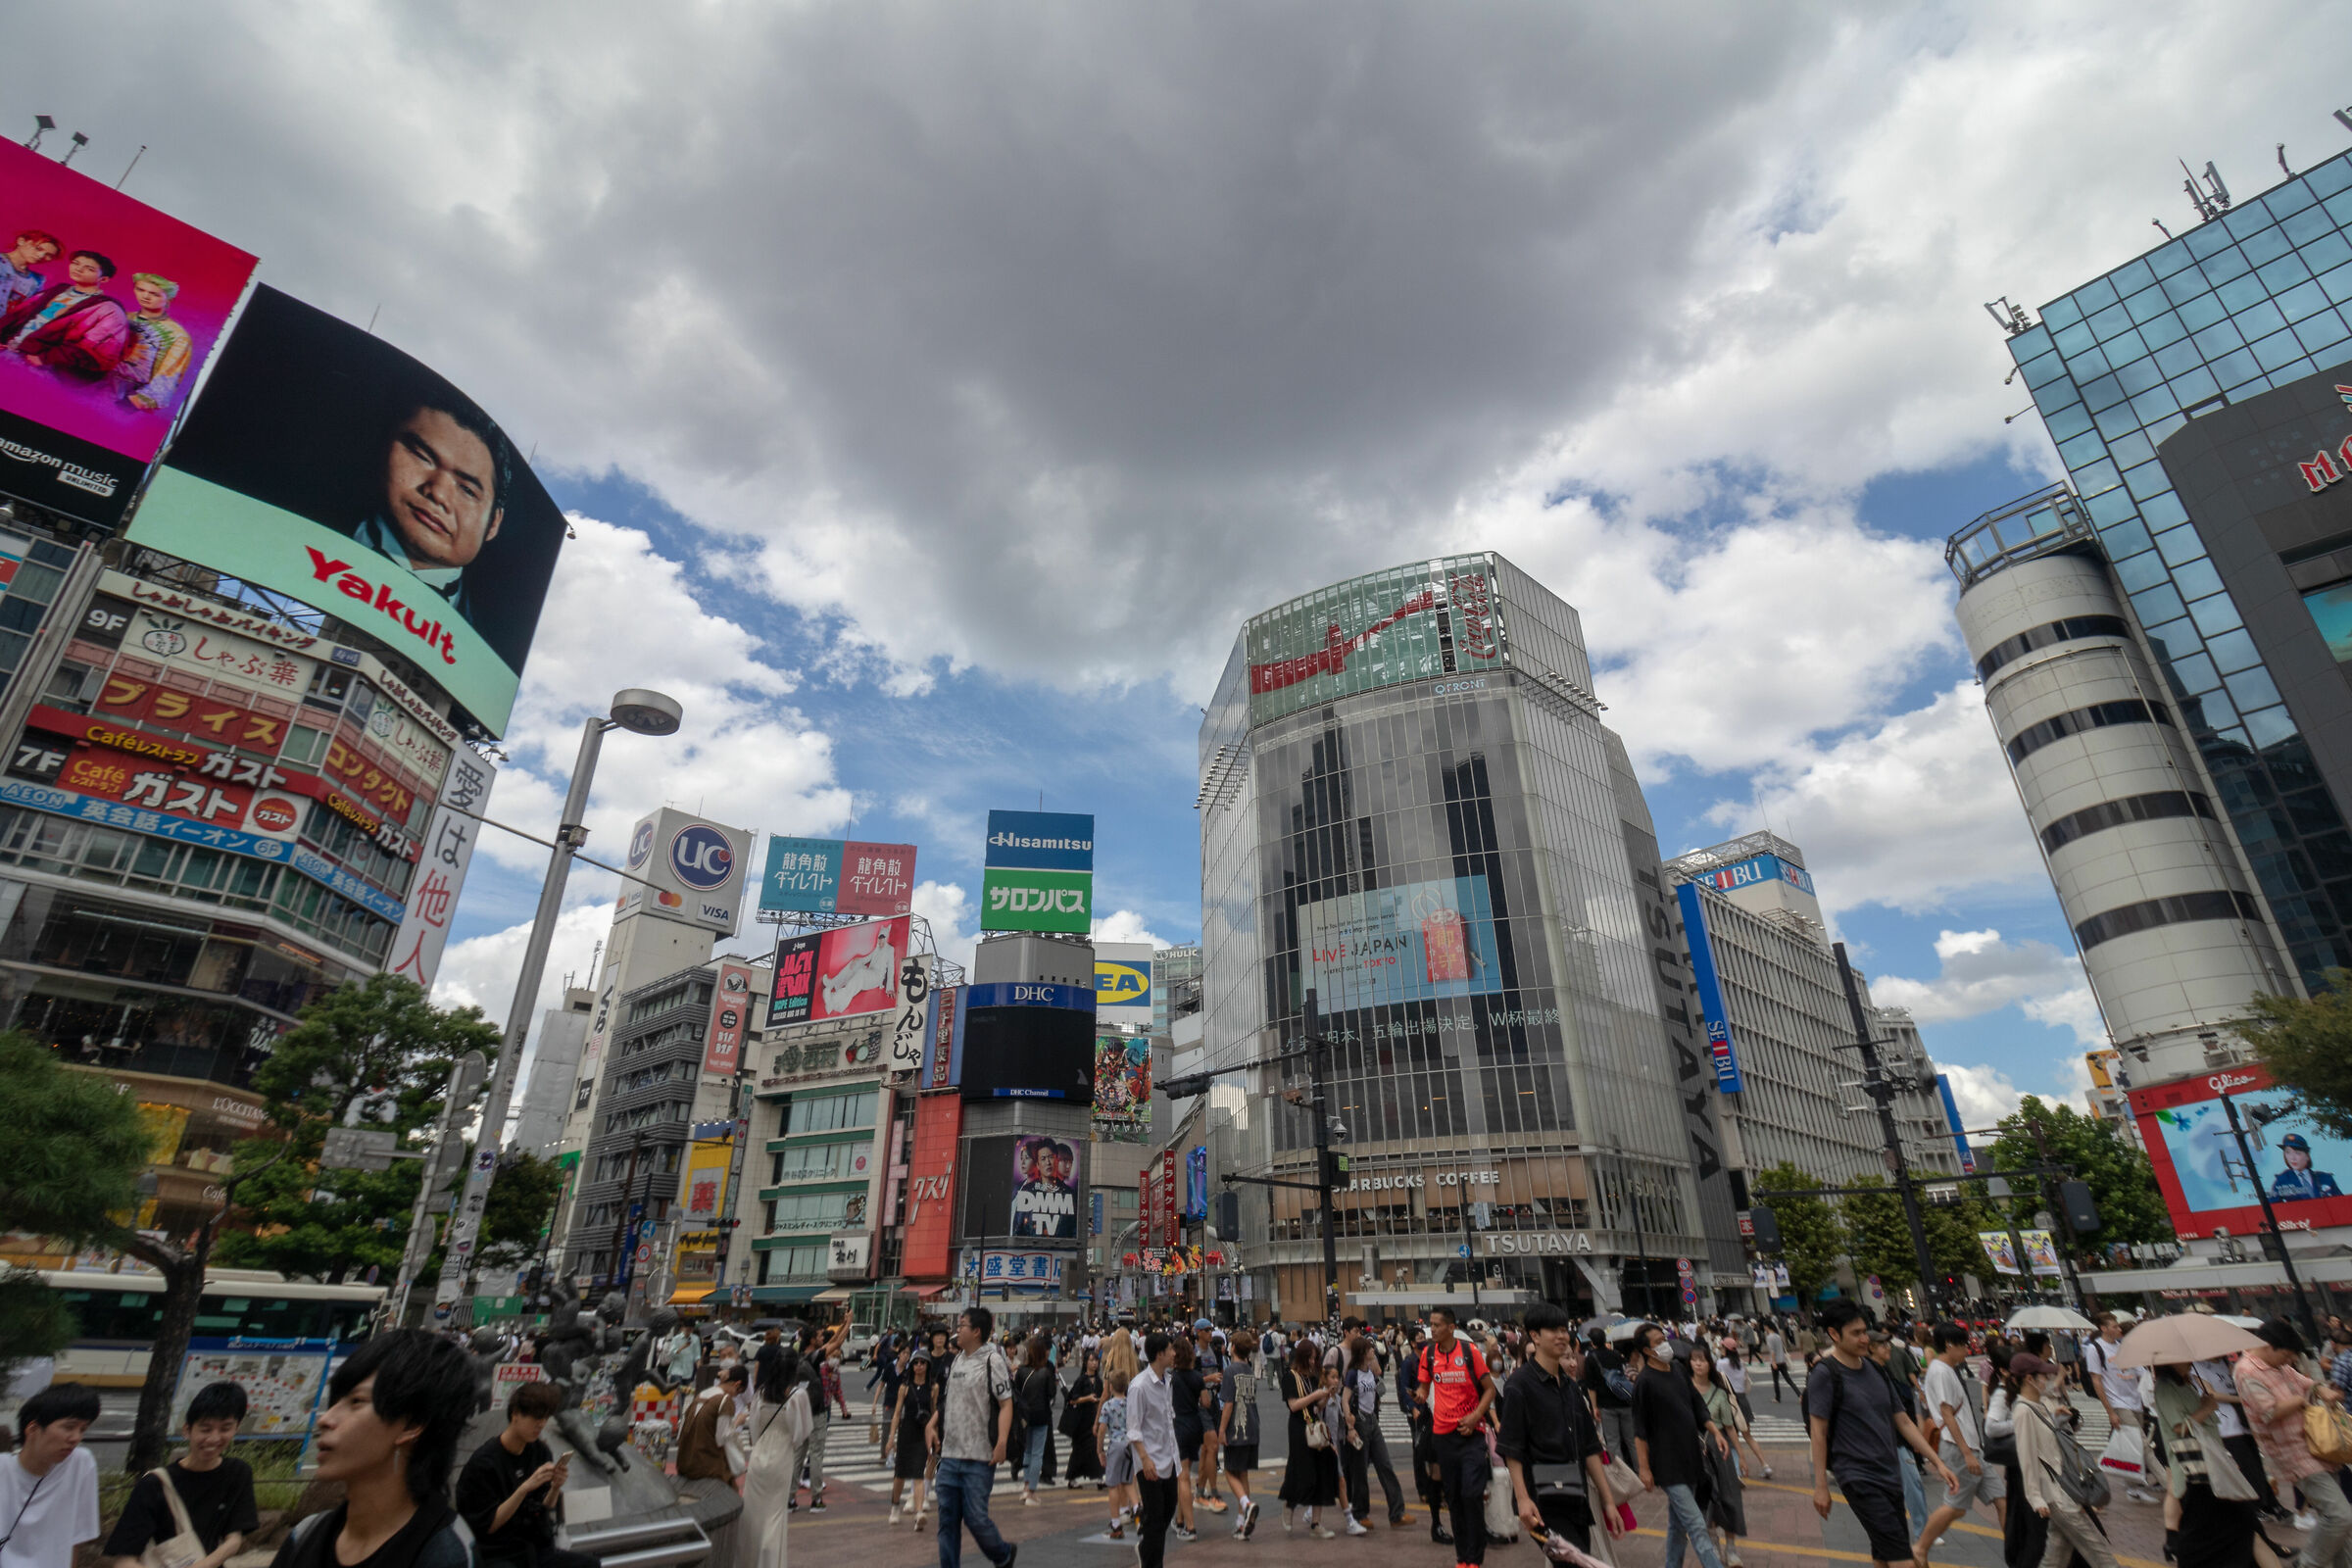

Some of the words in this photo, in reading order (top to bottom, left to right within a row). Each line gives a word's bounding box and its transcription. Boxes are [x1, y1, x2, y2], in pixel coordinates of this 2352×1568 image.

[63, 462, 119, 488] music
[132, 581, 318, 650] しゃぶしゃぶバイキング
[305, 545, 456, 664] Yakult
[86, 609, 127, 632] 9F
[193, 635, 299, 686] しゃぶ葉
[1435, 678, 1486, 695] QFRONT
[105, 679, 280, 746] プライス
[15, 745, 67, 772] 7F
[86, 725, 199, 764] Caféレストラン
[200, 752, 286, 789] ガスト
[395, 721, 445, 773] しゃぶ葉
[73, 759, 126, 784] Café
[326, 741, 410, 812] コンタクト
[2, 783, 66, 808] AEON
[69, 775, 120, 795] レストラン
[122, 771, 238, 820] ガスト
[257, 809, 292, 824] ガスト
[257, 841, 280, 857] 6F
[374, 823, 415, 858] ガスト
[631, 830, 652, 858] UC
[989, 832, 1092, 851] Hisamitsu
[677, 836, 727, 875] UC
[782, 852, 828, 872] 龍角散
[858, 857, 902, 877] 龍角散
[393, 759, 485, 986] 愛は他人
[774, 871, 833, 892] ダイレクト
[850, 875, 907, 896] ダイレクト
[1780, 862, 1812, 891] SEIBU
[990, 886, 1085, 913] サロンパス
[703, 906, 729, 921] VISA
[1169, 949, 1198, 958] HULIC
[1313, 944, 1347, 963] LIVE
[1351, 935, 1407, 956] JAPAN
[780, 951, 814, 977] JACK
[1364, 956, 1396, 969] TOKYO
[1014, 986, 1054, 1002] DHC
[1094, 974, 1142, 992] EA
[894, 958, 929, 1064] もんじゃ
[1638, 866, 1721, 1180] TSUTAYA
[933, 989, 953, 1083] 三千里薬品
[1707, 1020, 1735, 1081] SEIBU
[1025, 1089, 1049, 1098] Channel
[2209, 1074, 2256, 1094] Glico
[1165, 1156, 1174, 1205] カラオケ
[1331, 1175, 1425, 1193] ARBUCKS
[1436, 1171, 1499, 1186] COFFEE
[691, 1181, 716, 1213] 薬
[1017, 1191, 1074, 1215] DMM
[1032, 1213, 1059, 1236] TV
[1486, 1233, 1592, 1253] TSUTAYA
